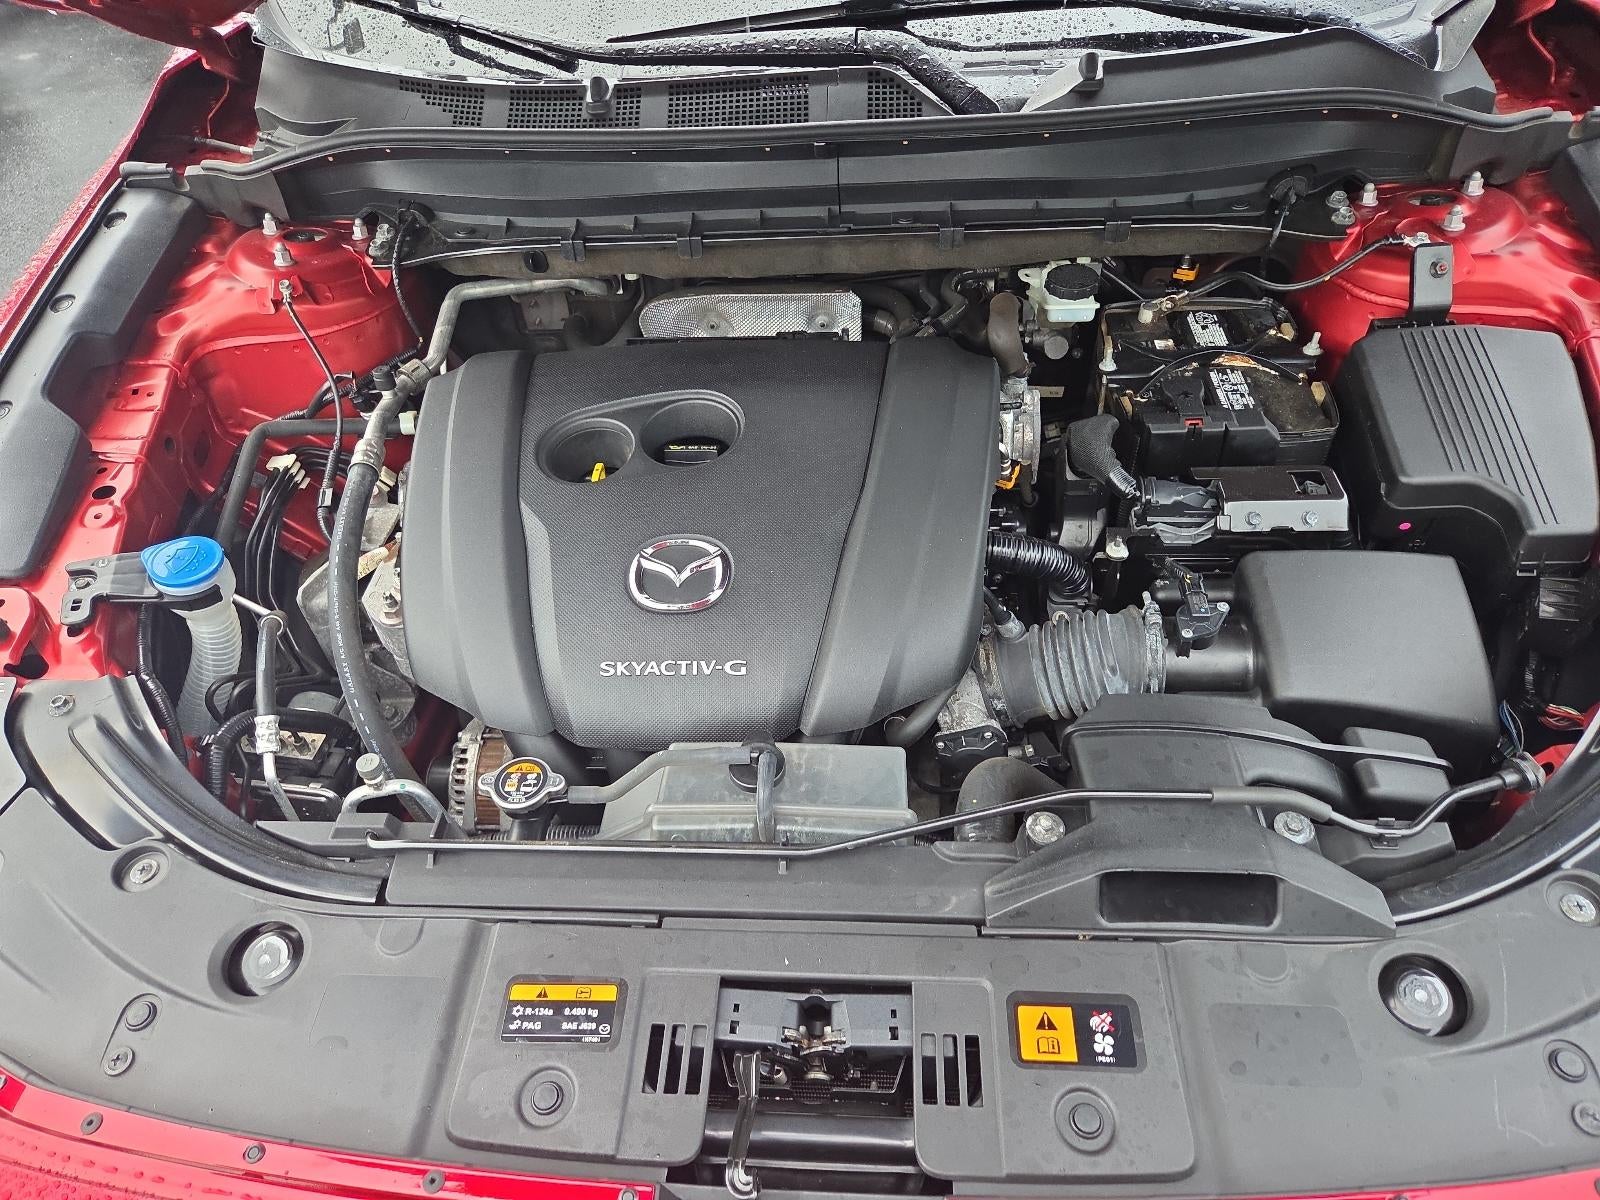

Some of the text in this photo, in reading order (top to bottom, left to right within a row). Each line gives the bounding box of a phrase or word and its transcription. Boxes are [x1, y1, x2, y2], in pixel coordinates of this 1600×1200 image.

[599, 660, 747, 677] SKYACTIV-G
[524, 1007, 554, 1016] R-134a
[587, 1008, 599, 1018] kg
[521, 1021, 542, 1030] PAG
[561, 1021, 578, 1030] SAE
